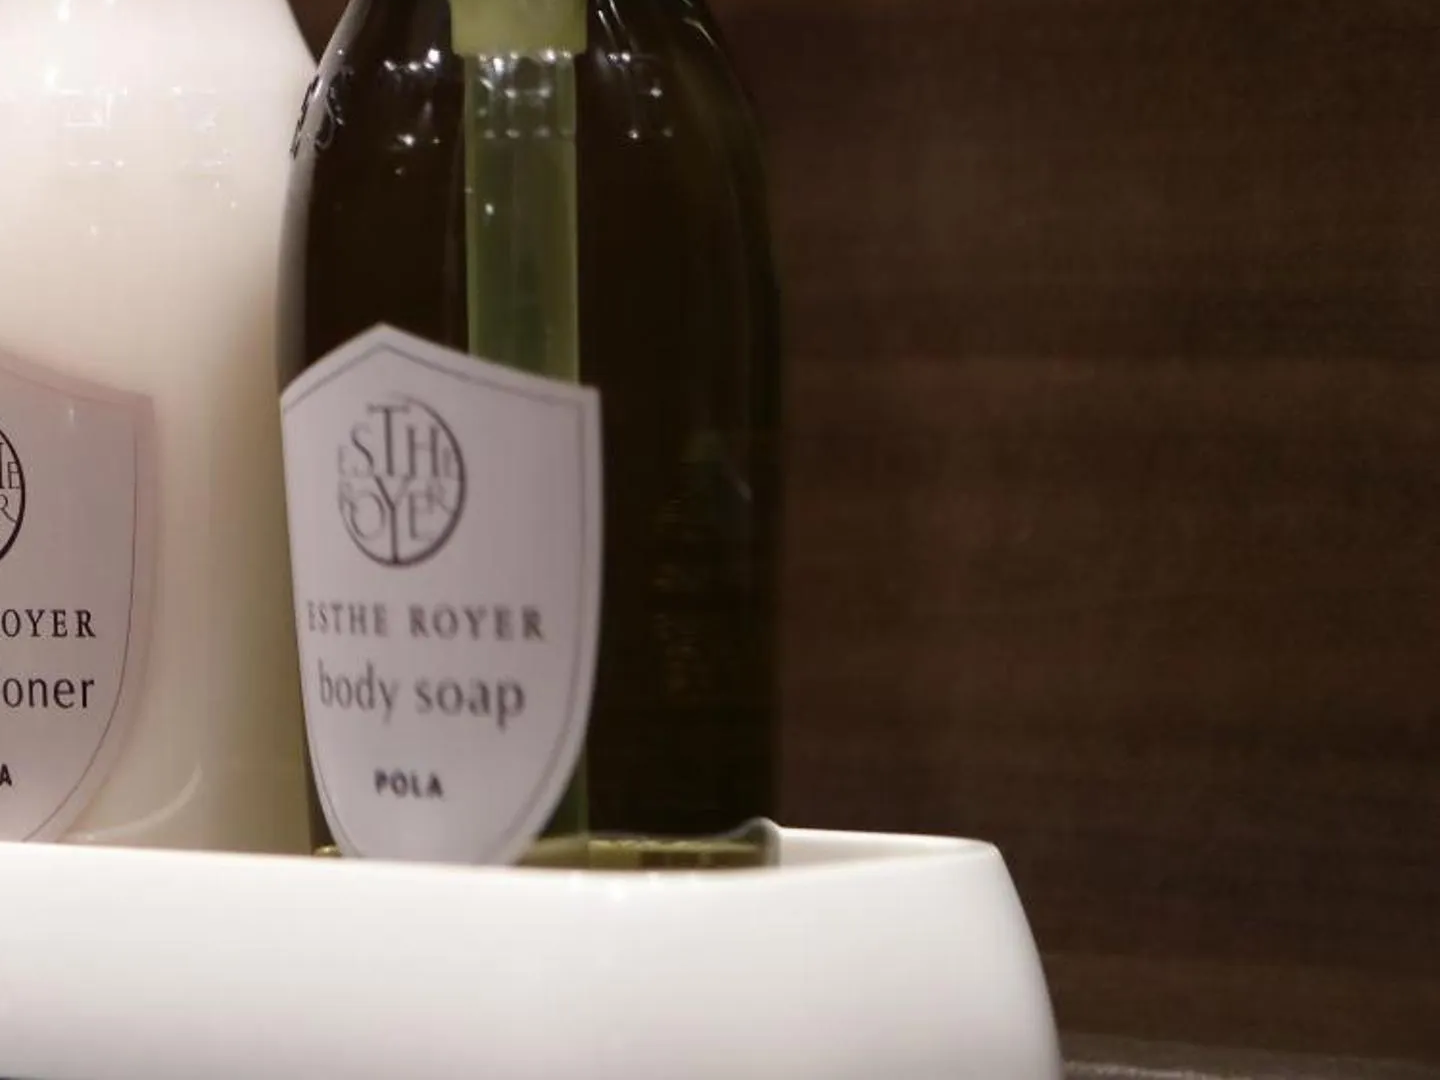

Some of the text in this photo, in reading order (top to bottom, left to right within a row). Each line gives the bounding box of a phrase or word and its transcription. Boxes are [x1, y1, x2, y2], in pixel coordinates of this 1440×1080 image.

[307, 601, 546, 643] ESTHE ROYER
[319, 658, 525, 731] body soap
[374, 768, 445, 800] POLA
